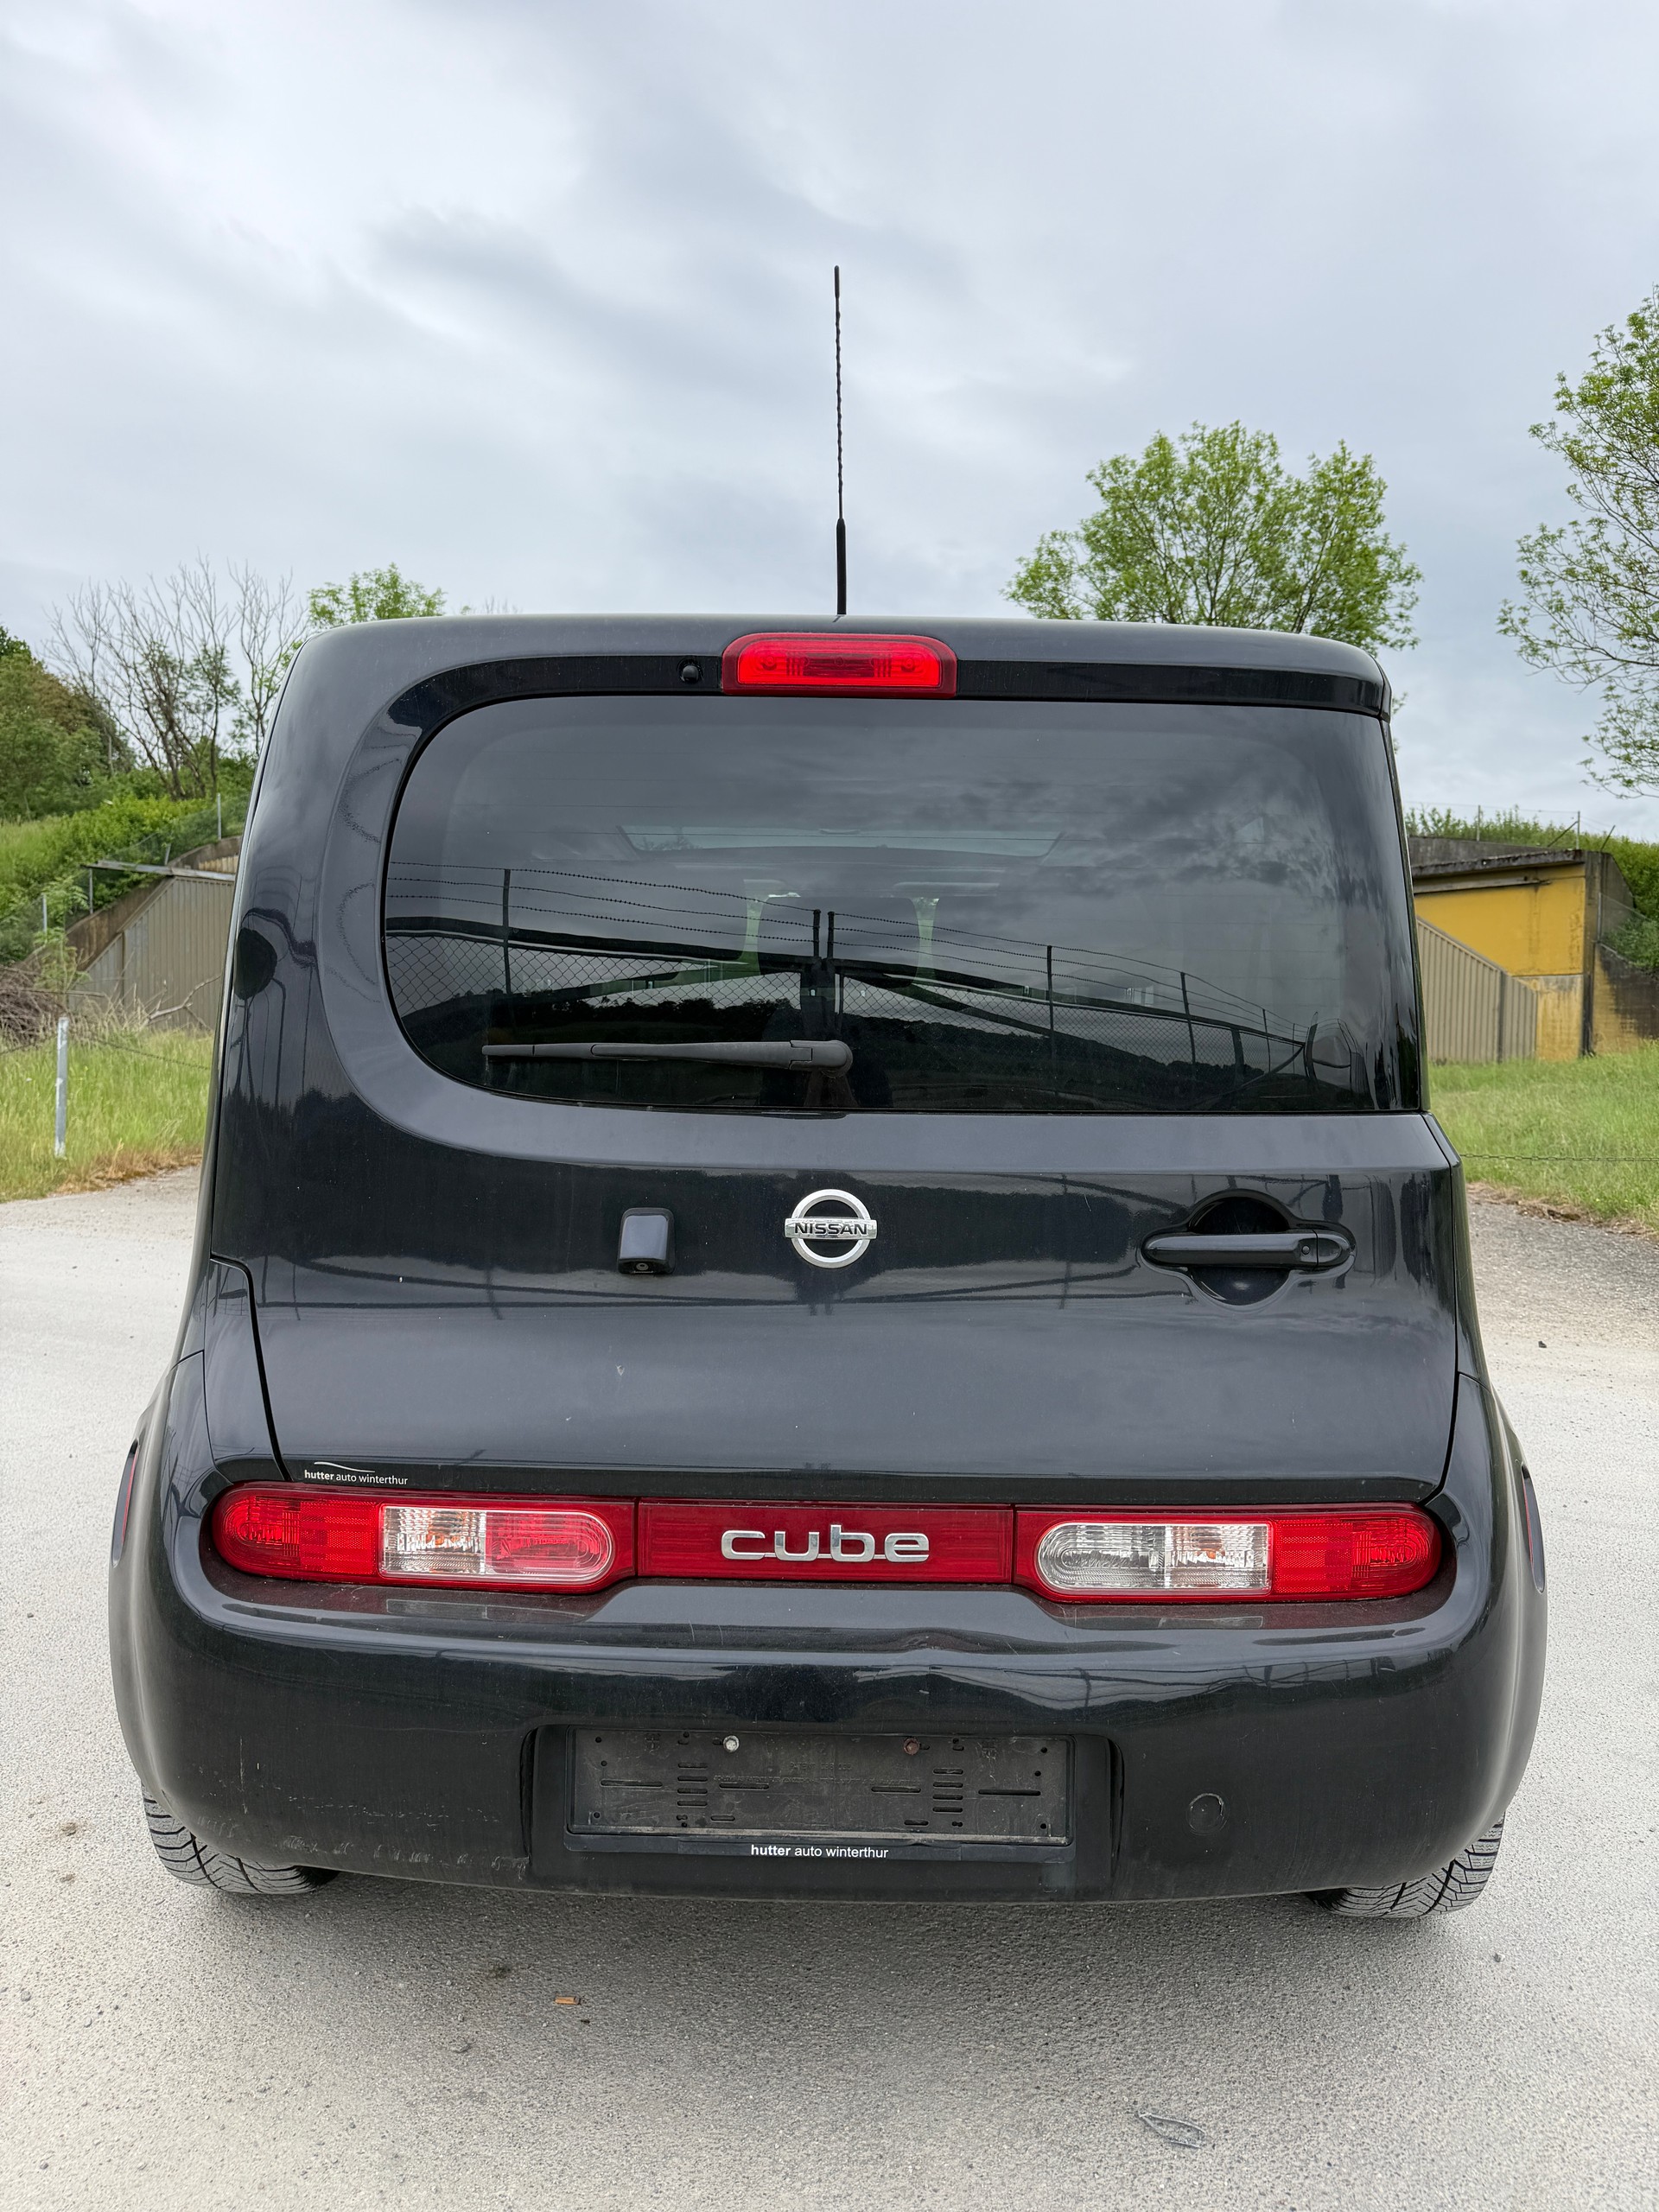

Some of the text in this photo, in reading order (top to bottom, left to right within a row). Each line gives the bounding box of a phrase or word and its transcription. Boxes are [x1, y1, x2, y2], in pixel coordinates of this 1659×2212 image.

[794, 1222, 868, 1236] NISSAN
[304, 1469, 409, 1485] hutter auto winterthur
[721, 1523, 930, 1562] cube
[750, 1844, 889, 1859] hutter auto winterthur
